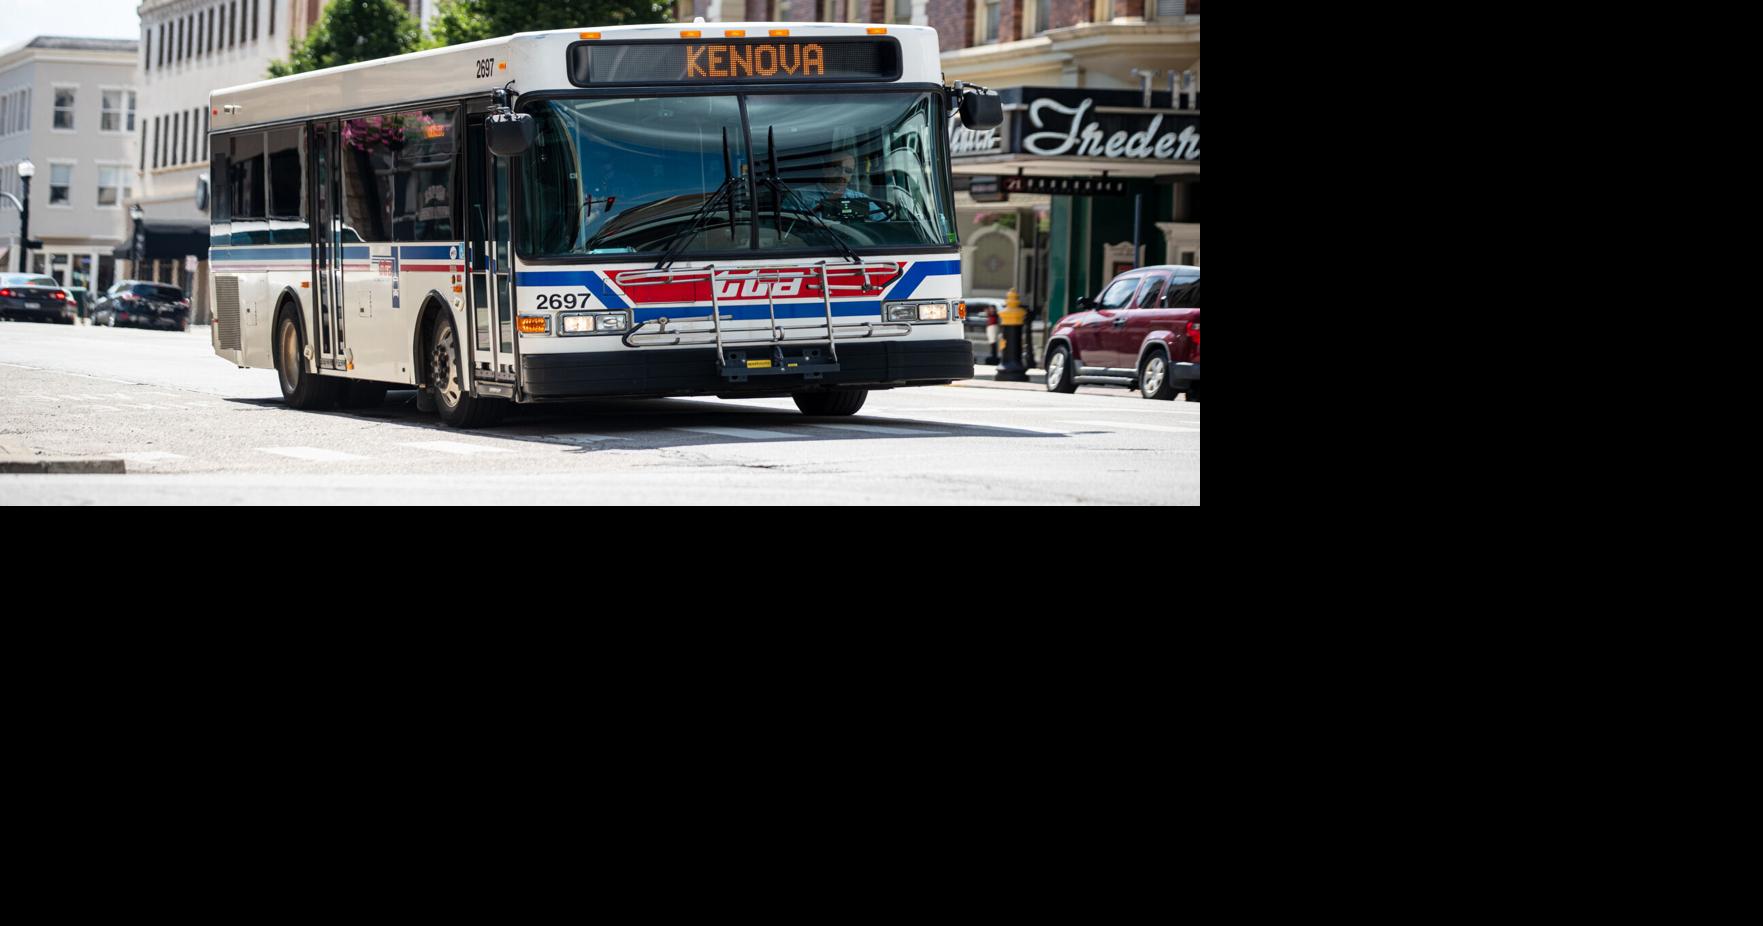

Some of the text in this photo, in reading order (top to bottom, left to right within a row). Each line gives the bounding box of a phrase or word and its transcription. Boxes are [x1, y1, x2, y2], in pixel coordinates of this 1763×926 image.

[476, 58, 495, 78] 2697
[686, 44, 825, 77] KENOVA
[536, 293, 591, 310] 2697
